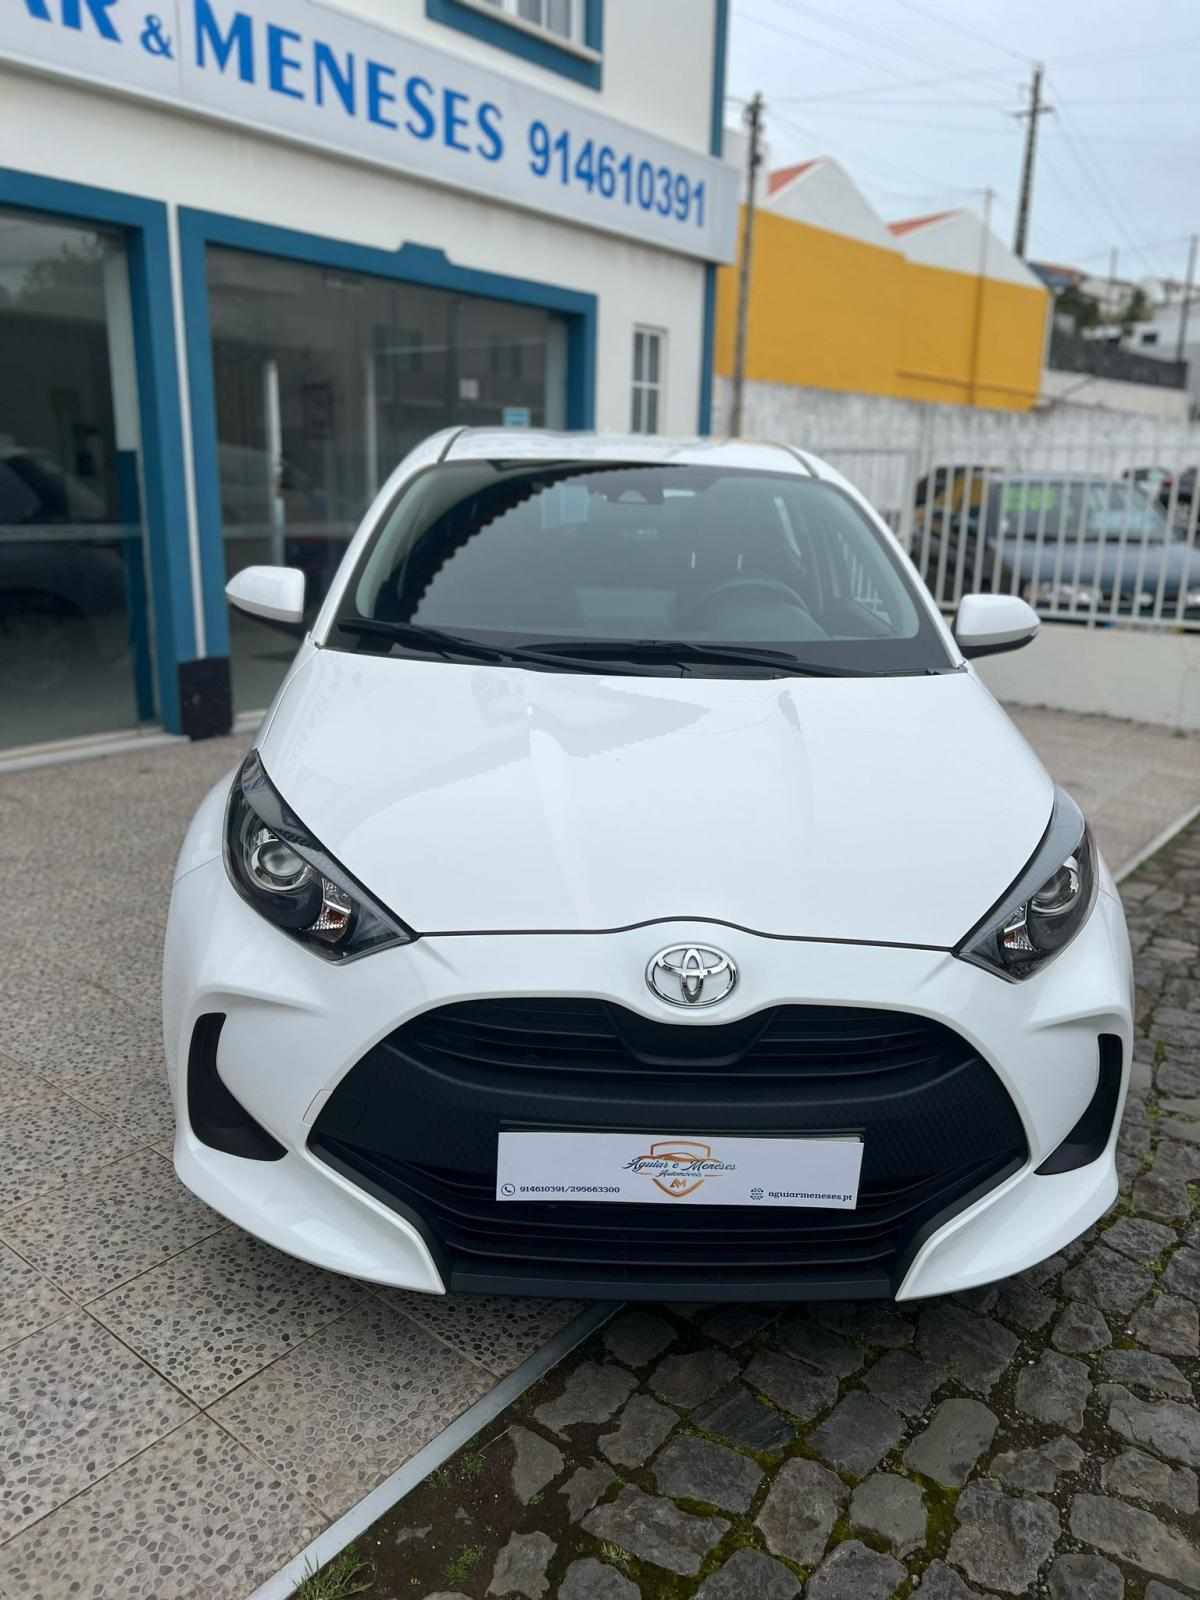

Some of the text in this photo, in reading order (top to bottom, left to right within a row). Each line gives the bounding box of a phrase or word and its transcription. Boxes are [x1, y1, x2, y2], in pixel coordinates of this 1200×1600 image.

[140, 13, 175, 60] &
[193, 0, 505, 162] MENESES
[529, 119, 706, 228] 914610391
[623, 1157, 669, 1173] Aguiar
[681, 1159, 737, 1171] Meneses
